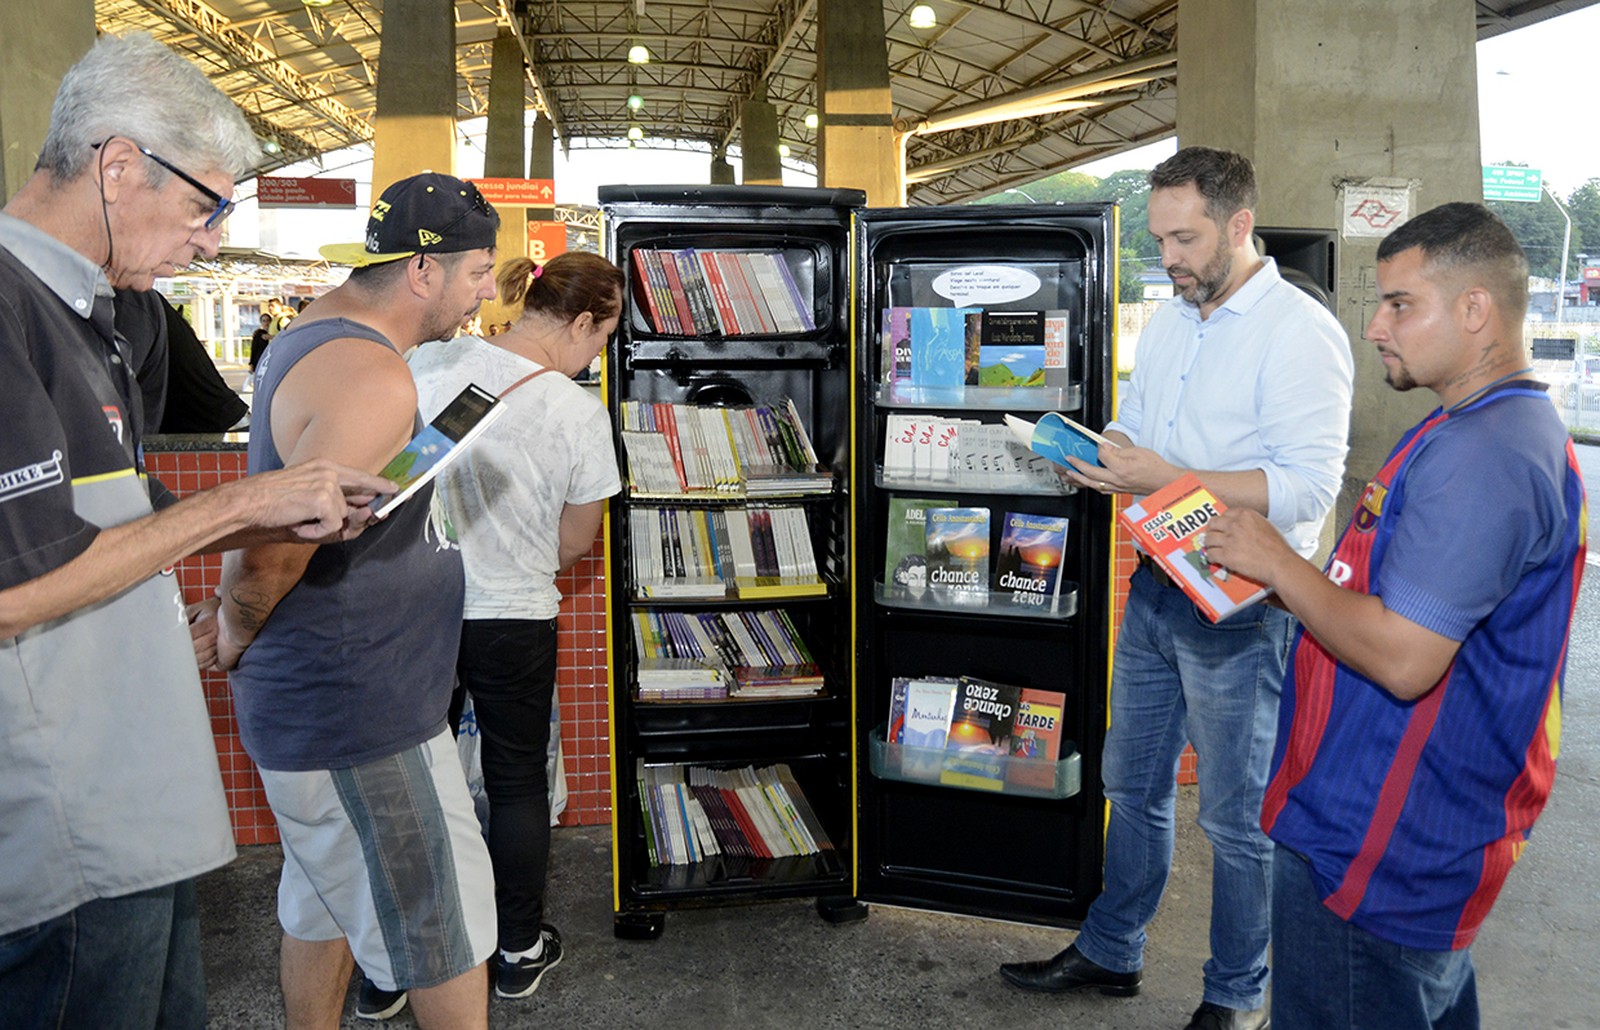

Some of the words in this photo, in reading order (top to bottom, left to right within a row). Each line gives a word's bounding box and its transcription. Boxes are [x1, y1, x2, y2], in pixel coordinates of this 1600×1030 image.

[530, 240, 546, 259] B
[1143, 511, 1174, 533] SESSÃO
[1166, 502, 1217, 539] TARDE
[1153, 529, 1167, 541] DA
[931, 565, 979, 583] chance
[999, 570, 1047, 592] chance
[1011, 590, 1044, 606] zero
[965, 684, 999, 701] zero
[963, 697, 1012, 721] chance
[1018, 712, 1055, 730] TARDE
